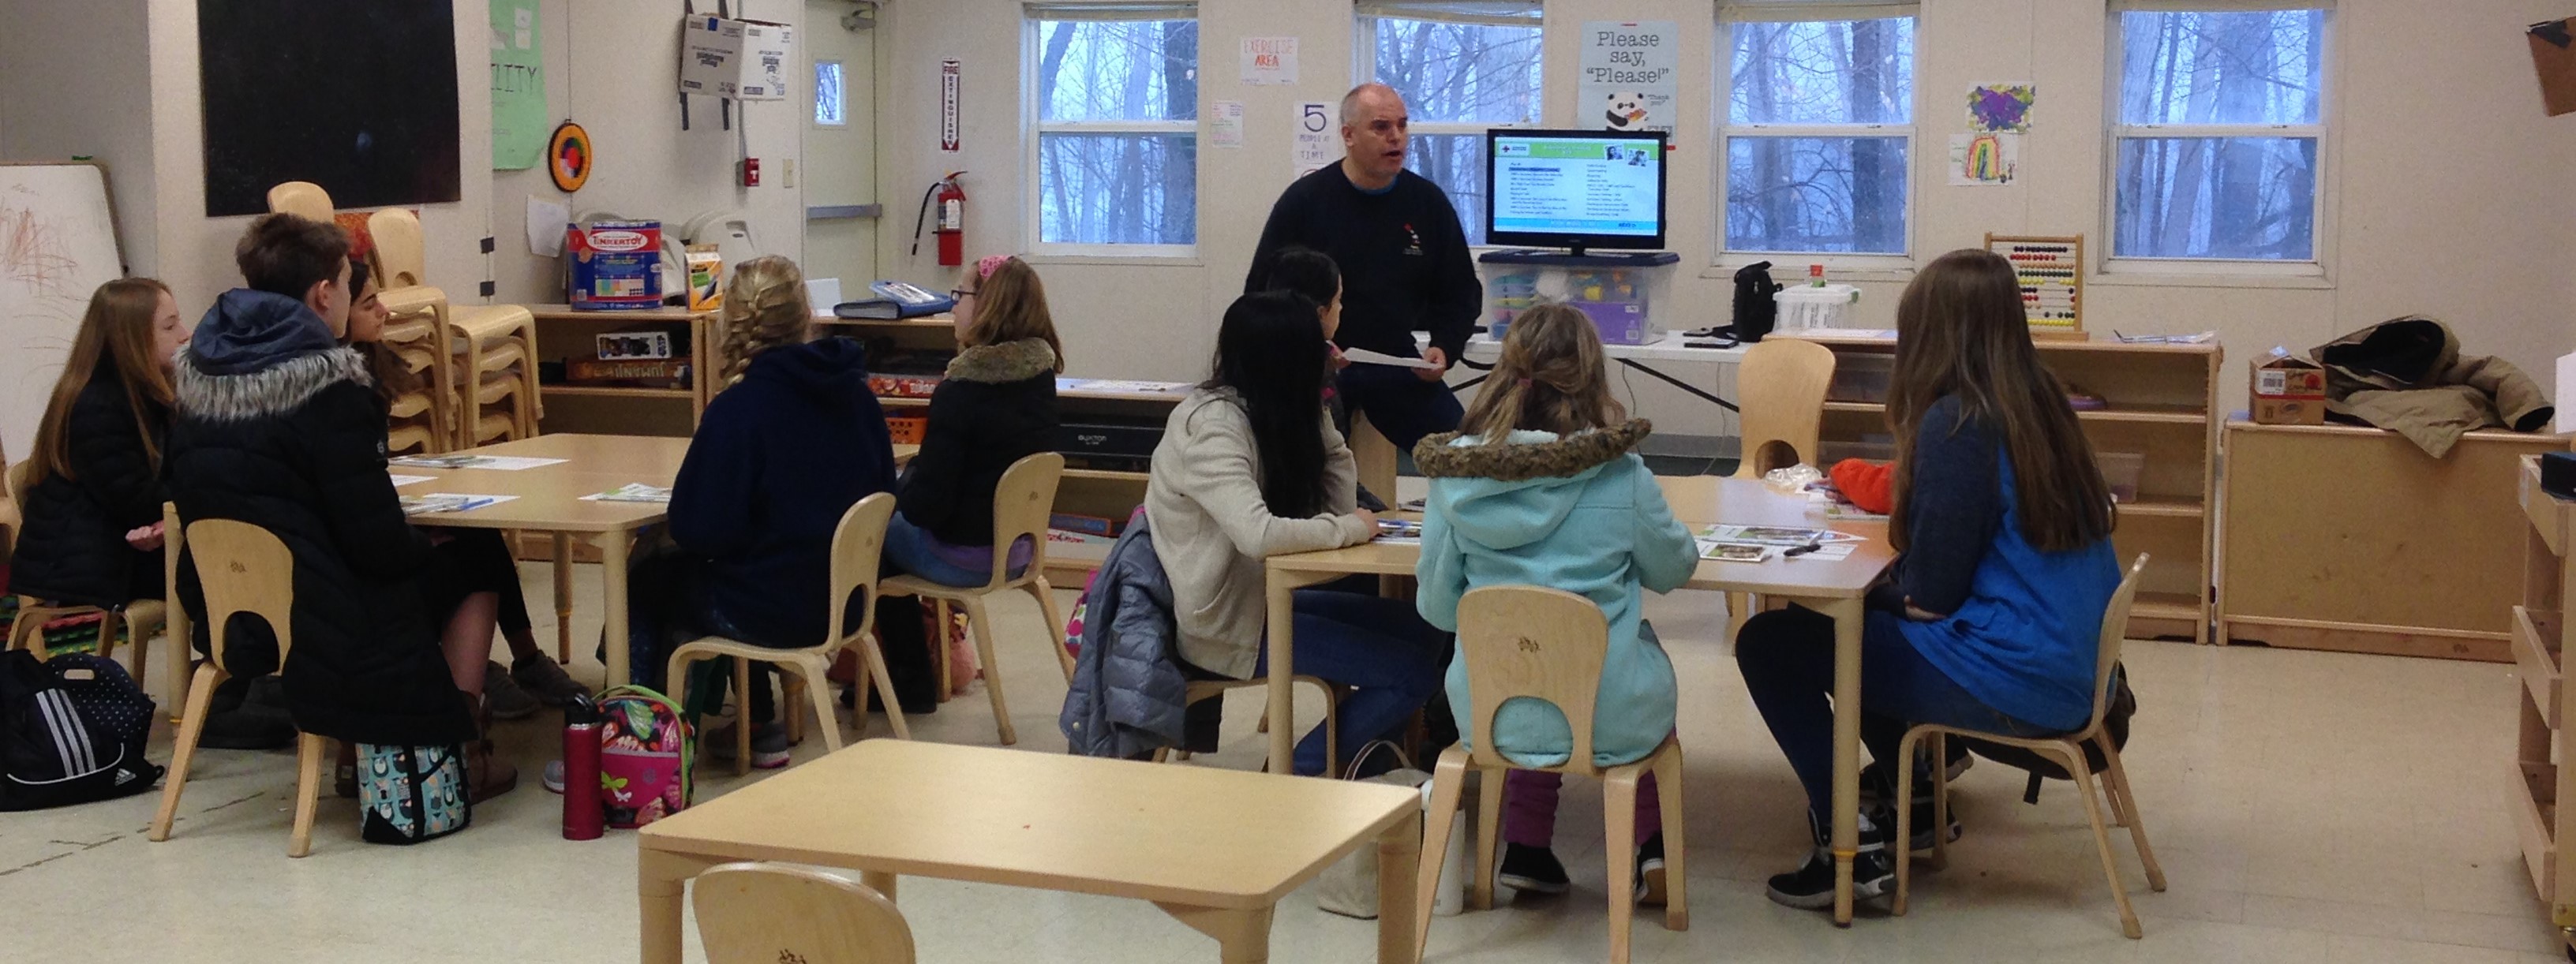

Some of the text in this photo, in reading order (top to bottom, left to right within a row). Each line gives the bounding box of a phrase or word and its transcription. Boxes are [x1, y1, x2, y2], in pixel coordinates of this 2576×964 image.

[1597, 32, 1659, 47] Please
[1255, 54, 1280, 67] AREA
[1610, 51, 1646, 67] say,
[1304, 104, 1327, 133] 5
[1300, 151, 1324, 160] TIME
